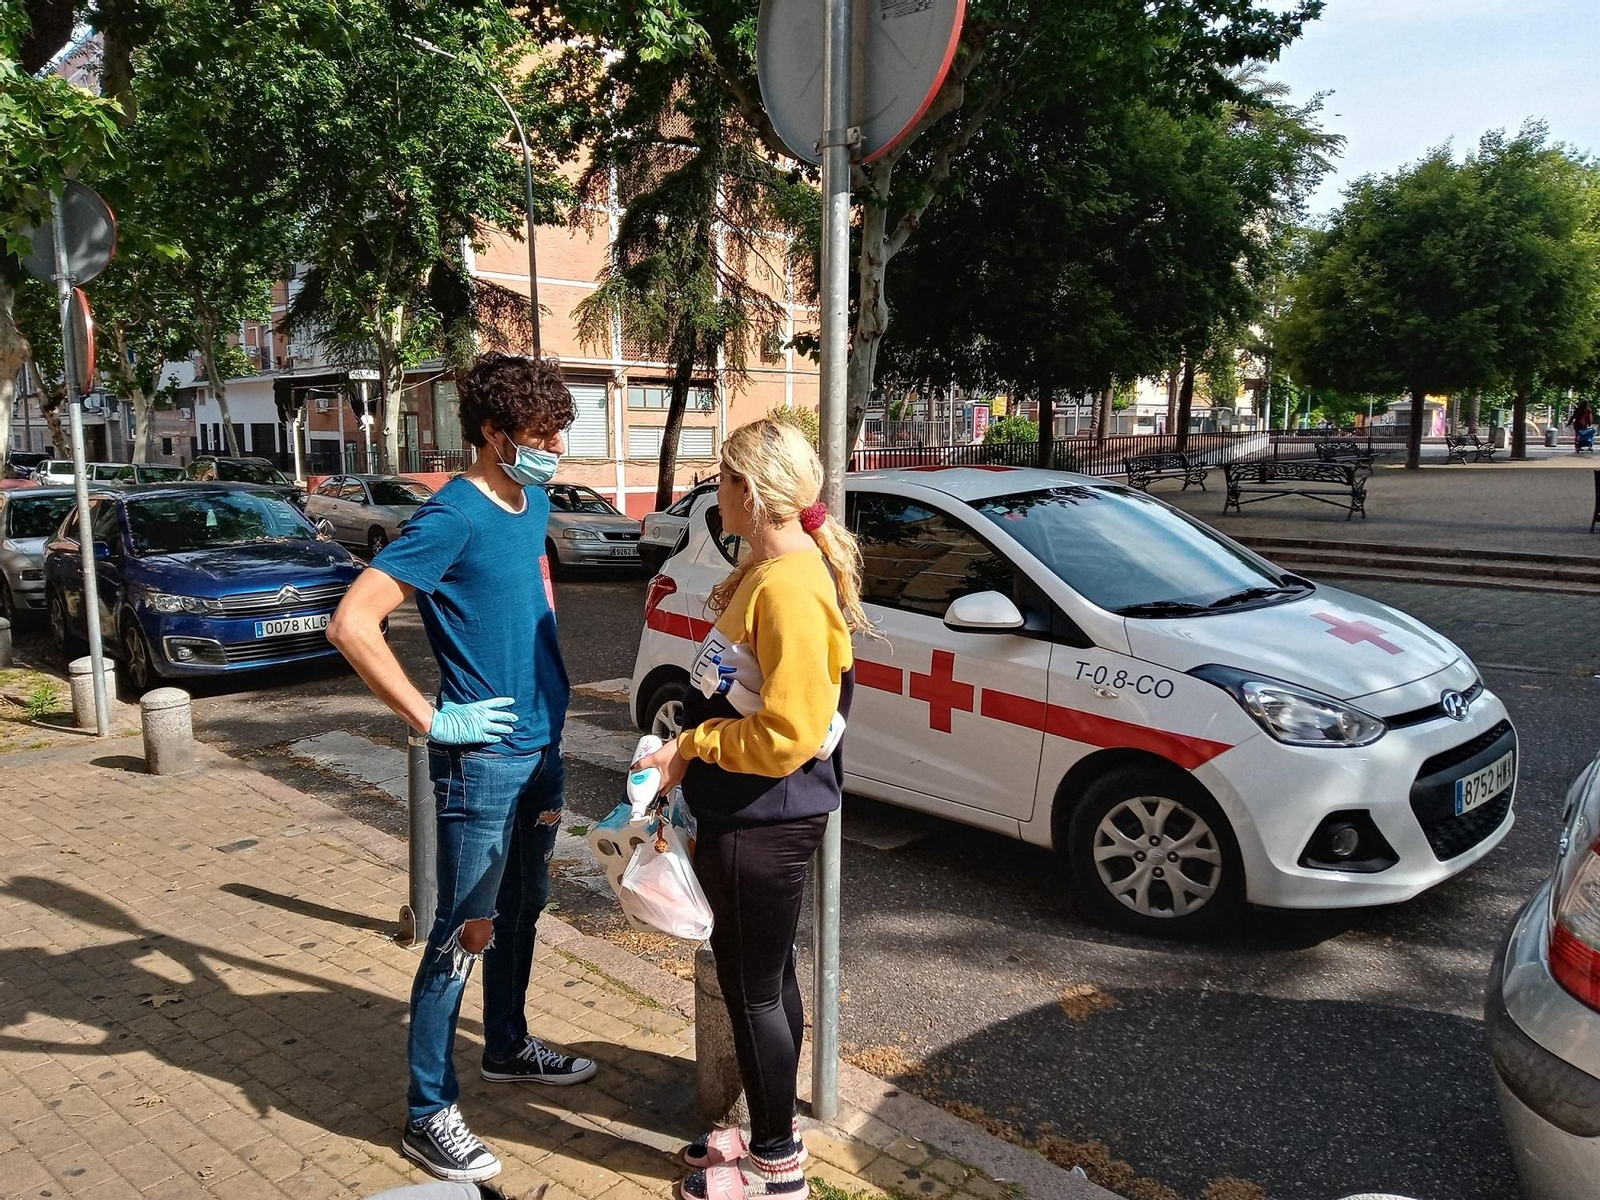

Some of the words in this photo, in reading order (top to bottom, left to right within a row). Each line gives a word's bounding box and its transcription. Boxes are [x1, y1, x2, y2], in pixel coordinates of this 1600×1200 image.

[265, 619, 300, 635] 0078
[303, 616, 328, 631] KLG
[1075, 660, 1175, 699] T-0.8-CO
[1465, 768, 1494, 806] 8752
